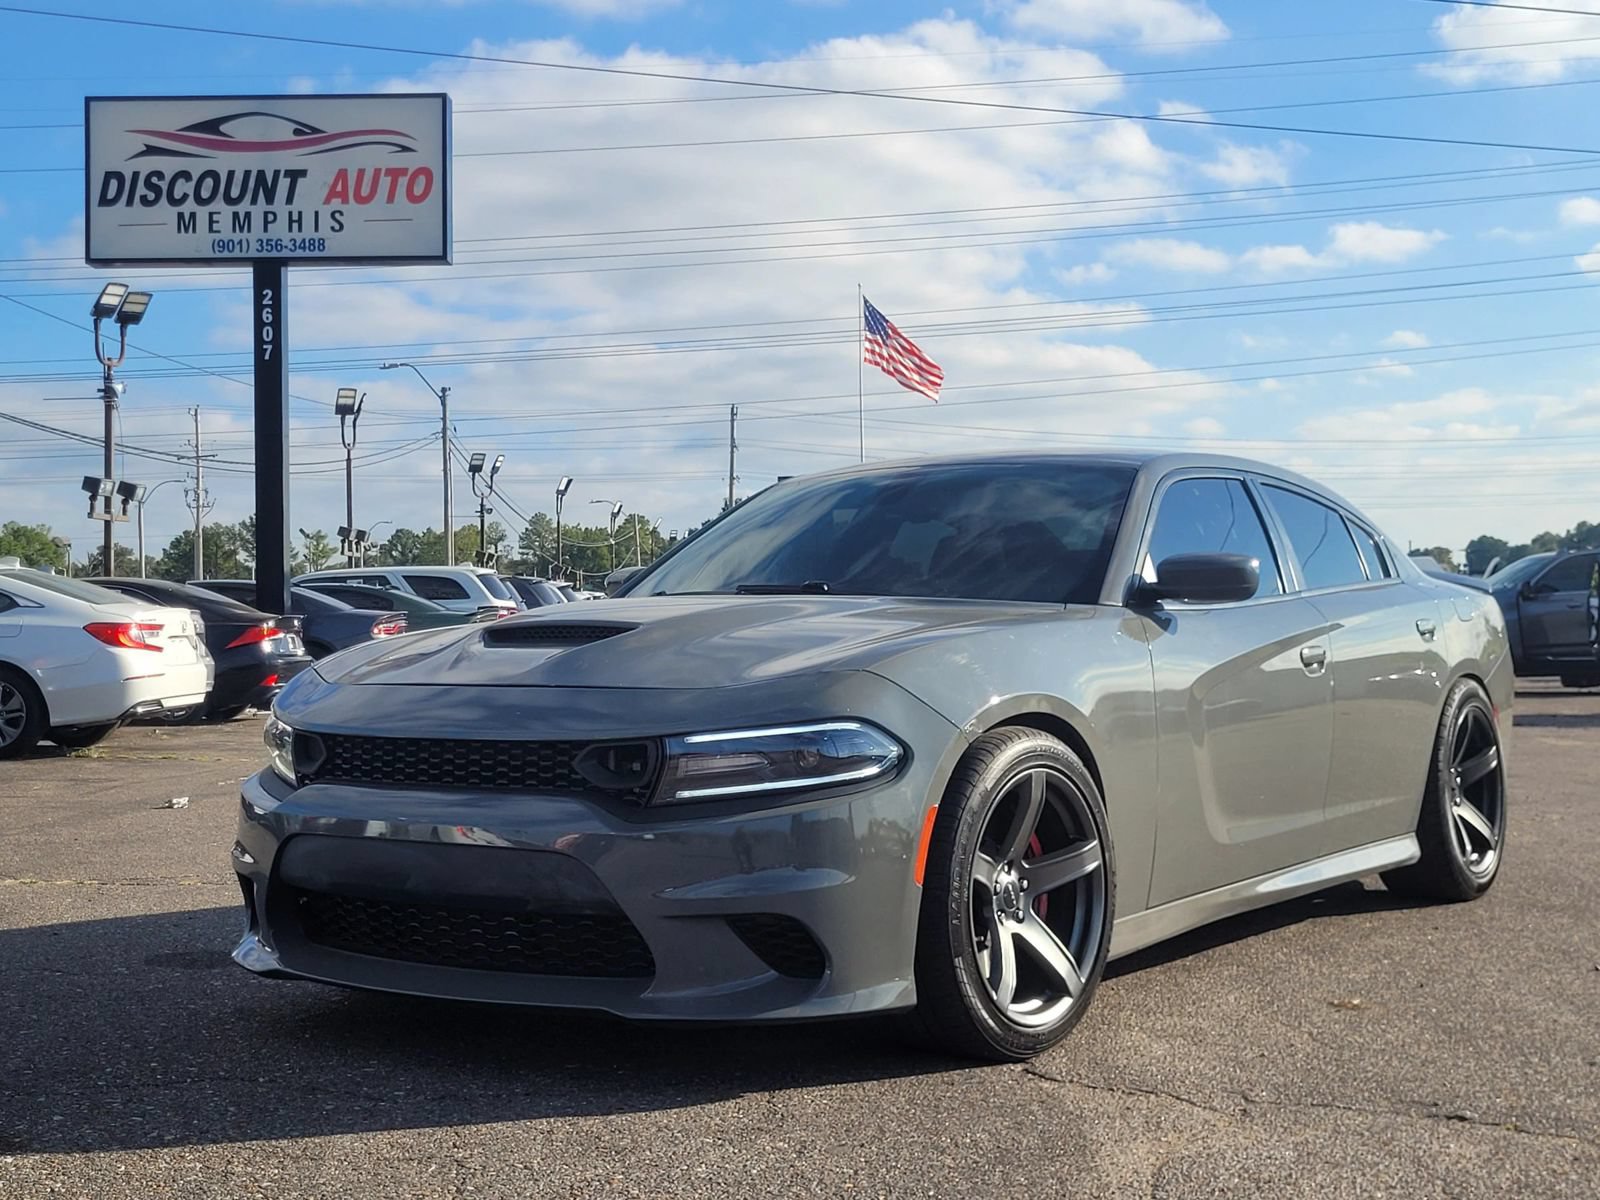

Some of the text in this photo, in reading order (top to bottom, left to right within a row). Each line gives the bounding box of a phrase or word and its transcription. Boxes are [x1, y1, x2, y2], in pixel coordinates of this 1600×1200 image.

[97, 166, 434, 208] DISCOUNT AUTO
[176, 210, 345, 235] MEMPHIS
[211, 237, 326, 255] (901) 356-3488
[261, 289, 273, 361] 2607
